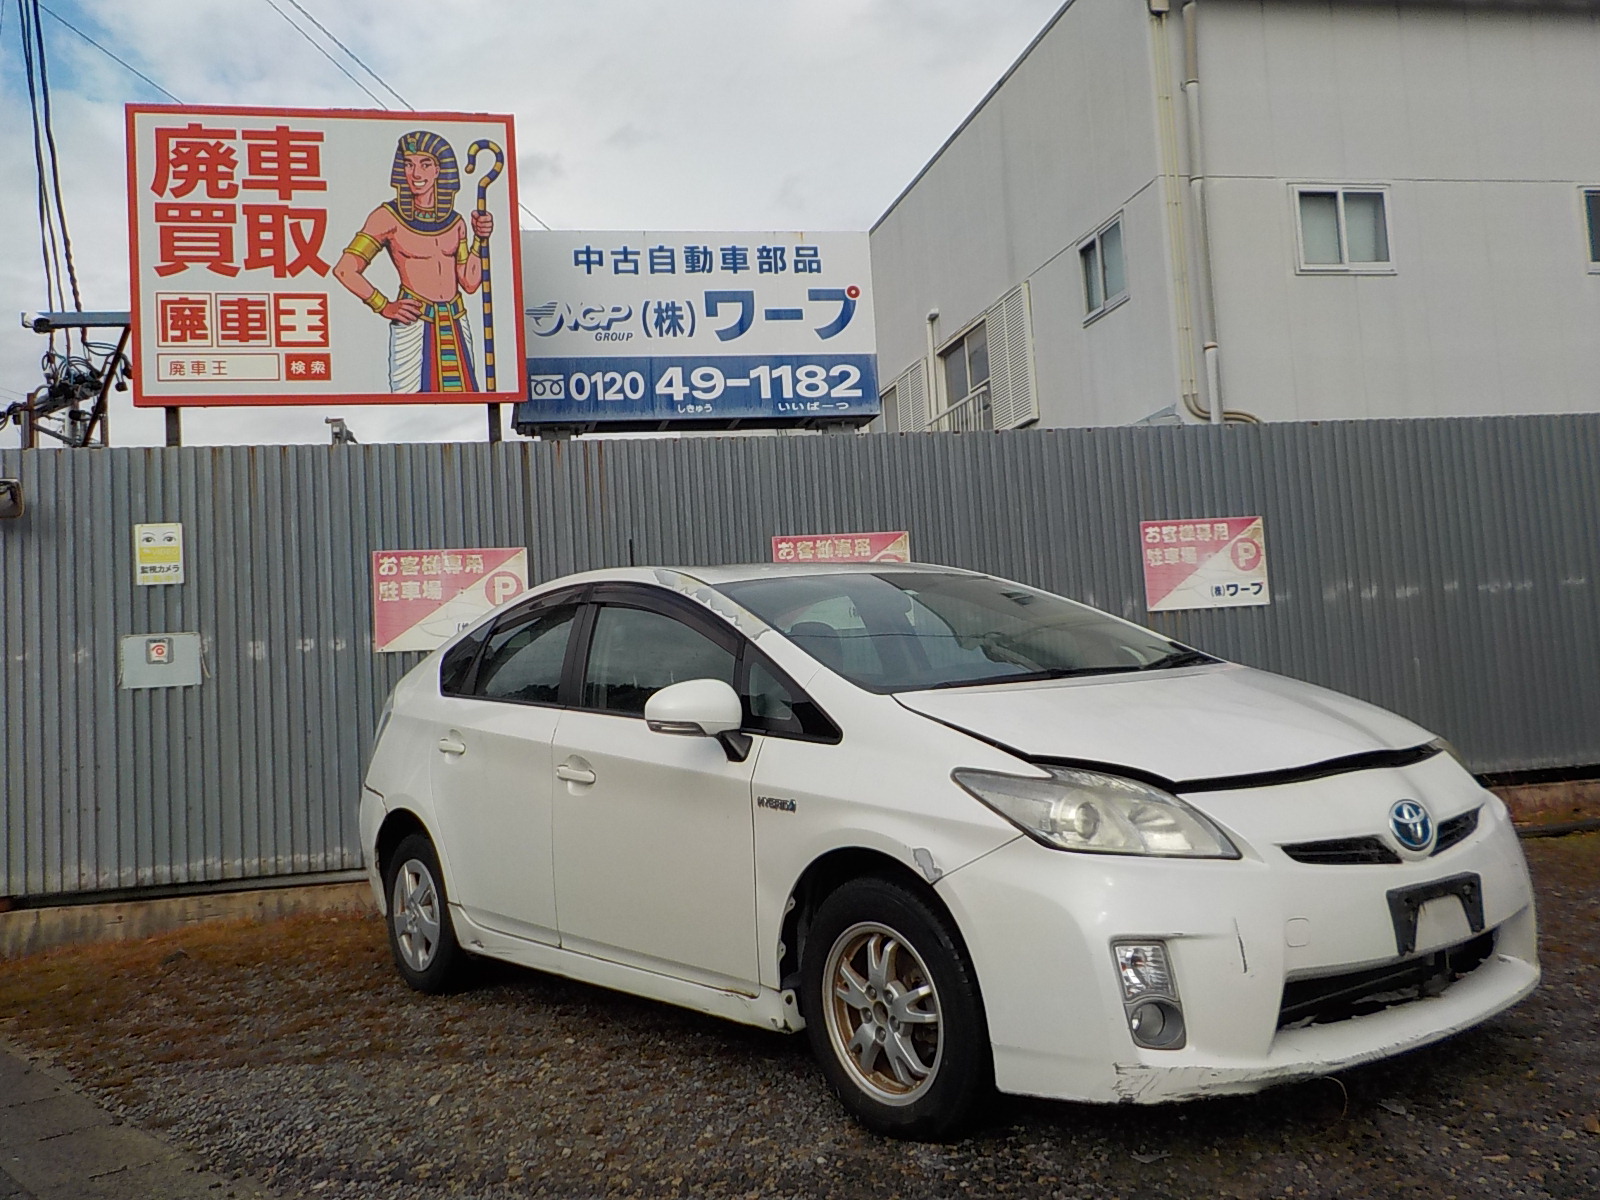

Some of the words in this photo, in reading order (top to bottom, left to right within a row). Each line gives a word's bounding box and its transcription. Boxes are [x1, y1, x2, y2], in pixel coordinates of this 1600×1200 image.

[150, 123, 327, 201] 廃車
[153, 202, 331, 279] 買取
[573, 245, 822, 275] 中古自動車部品
[158, 294, 329, 346] 廃車王
[595, 332, 633, 342] GROUP
[169, 360, 228, 376] 廃車王
[290, 360, 326, 374] 検索
[569, 371, 645, 402] 0120
[655, 364, 863, 401] 49-1182
[677, 403, 713, 413] しきゅう
[1145, 523, 1229, 543] お客様専用
[379, 554, 484, 576] お客様専用
[1237, 542, 1257, 567] P
[378, 580, 442, 602] 駐車場
[493, 576, 518, 605] P
